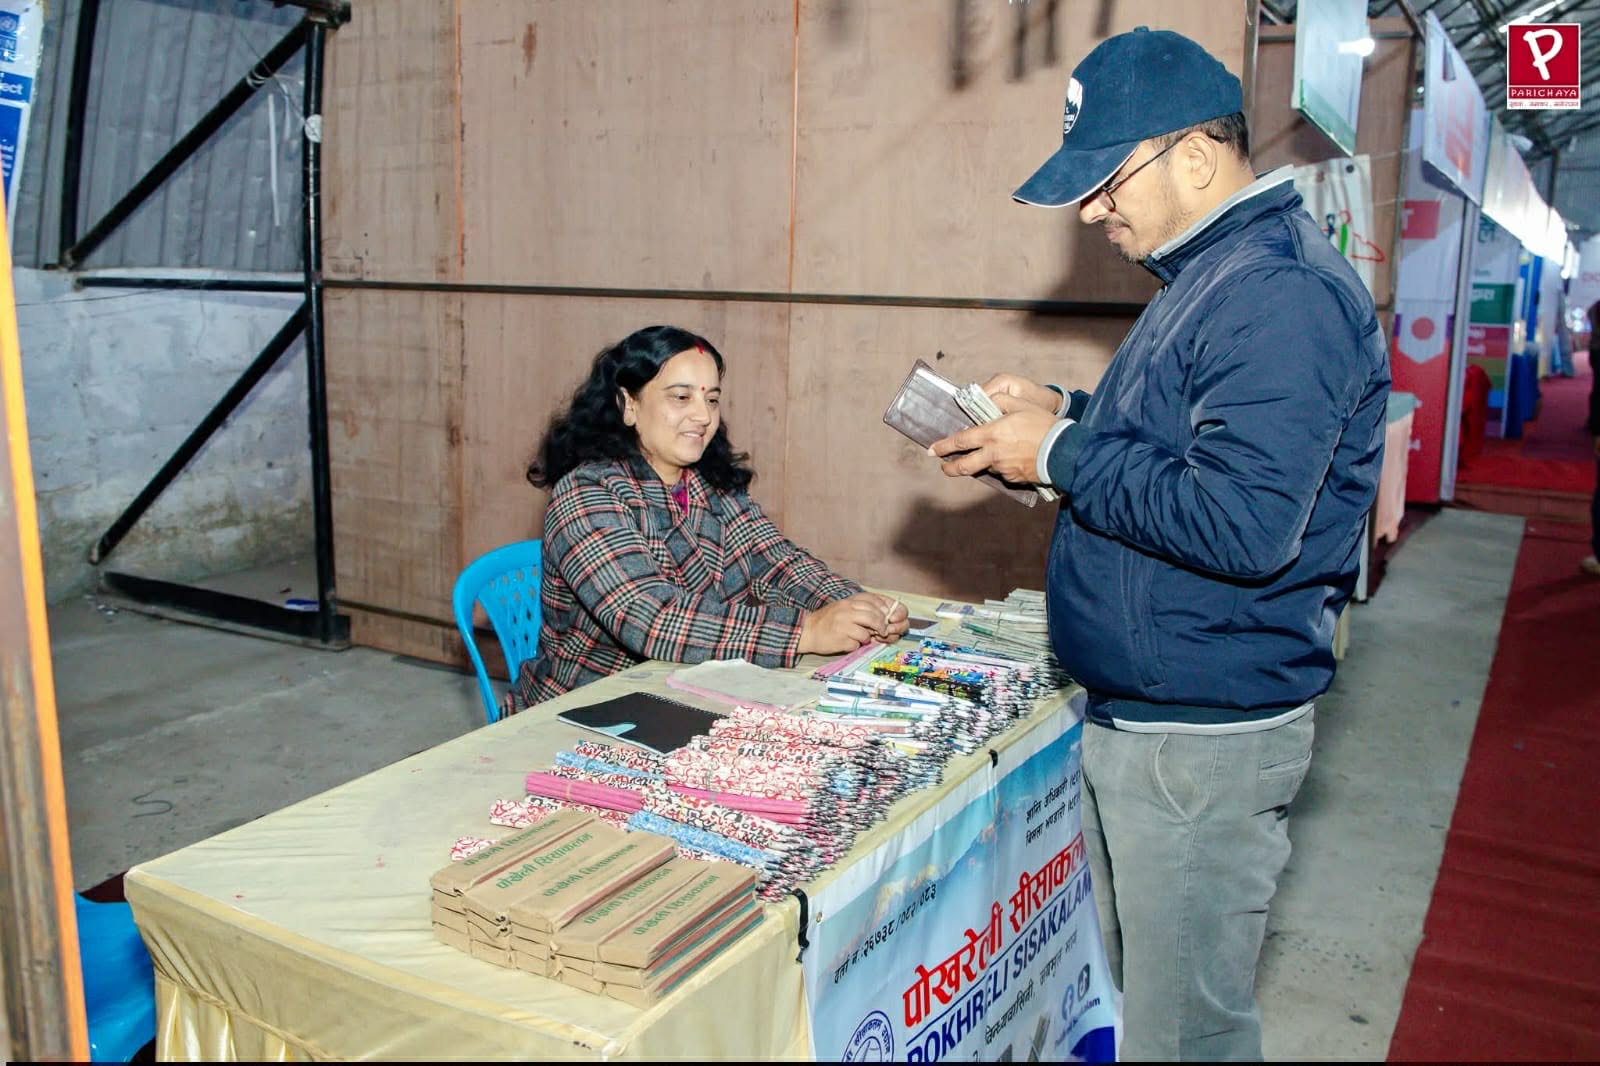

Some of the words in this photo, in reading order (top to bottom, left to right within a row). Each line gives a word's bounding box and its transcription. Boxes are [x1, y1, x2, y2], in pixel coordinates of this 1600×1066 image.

[902, 900, 1003, 1028] पोखरेली
[1008, 831, 1087, 934] सीसाकल
[1012, 869, 1092, 980] SISAKALAM
